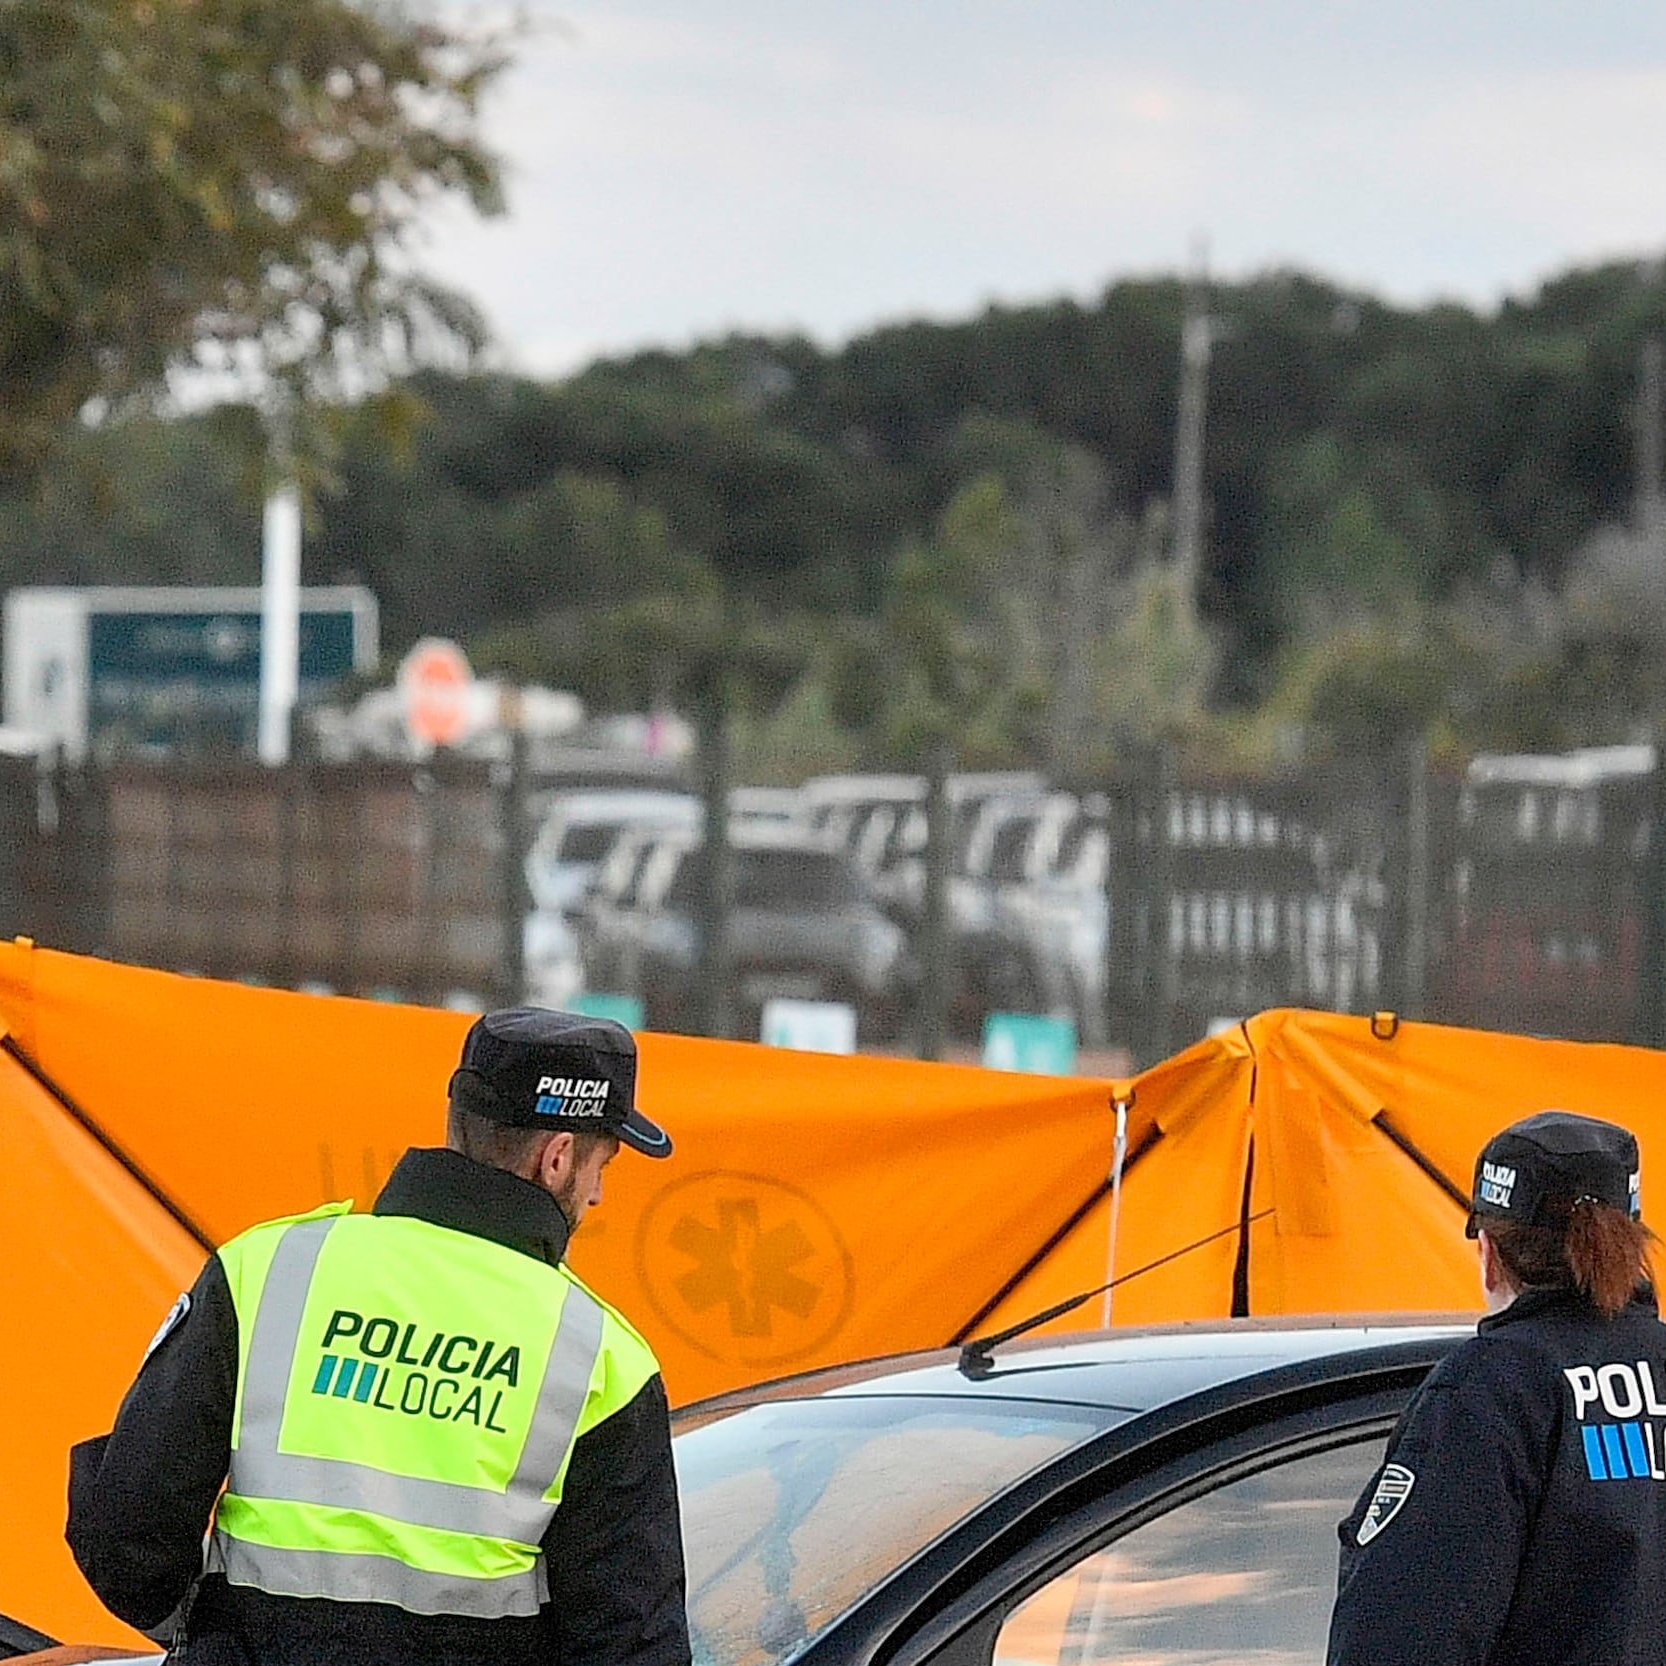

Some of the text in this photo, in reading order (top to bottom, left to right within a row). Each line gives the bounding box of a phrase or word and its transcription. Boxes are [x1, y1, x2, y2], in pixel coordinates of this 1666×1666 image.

[536, 1076, 610, 1099] POLICIA
[559, 1098, 606, 1117] LOCAL
[320, 1310, 521, 1388] POLICIA
[373, 1368, 506, 1434] LOCAL
